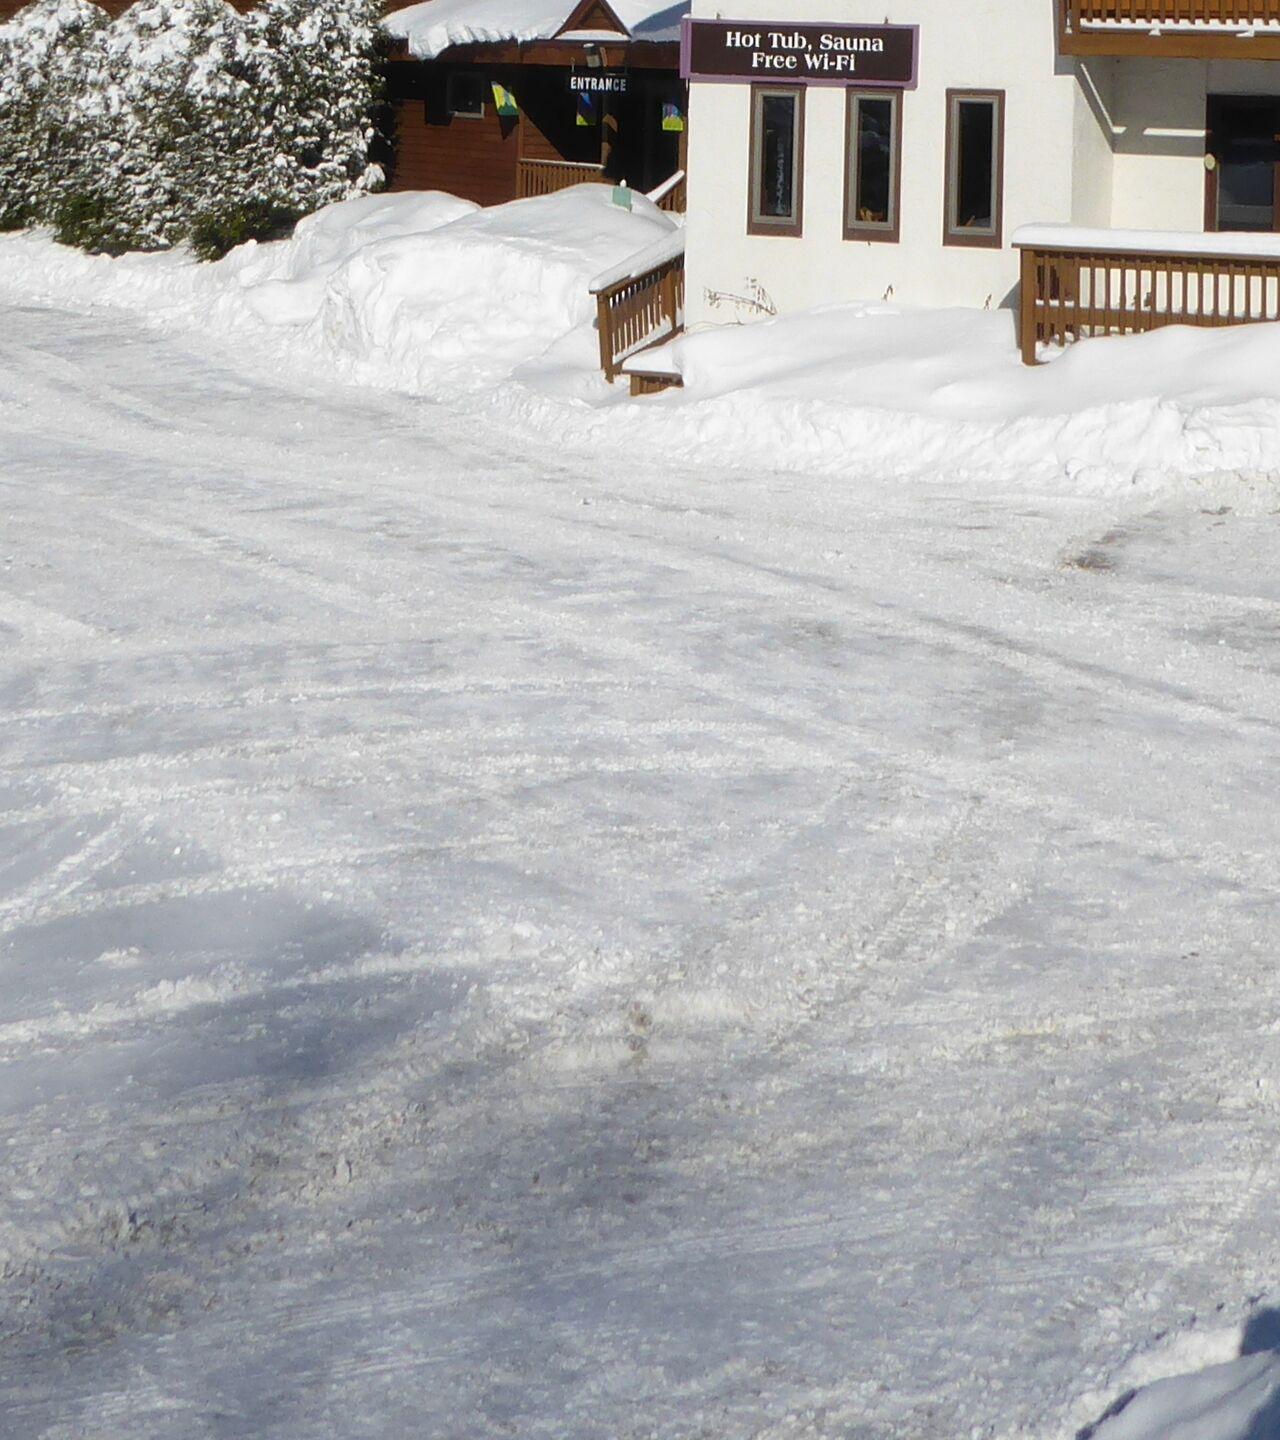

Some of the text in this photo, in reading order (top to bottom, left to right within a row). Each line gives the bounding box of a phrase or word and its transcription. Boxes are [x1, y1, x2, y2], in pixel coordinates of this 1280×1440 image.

[725, 31, 884, 52] Hot Tub, Sauna
[751, 52, 856, 71] Free Wi-Fi
[570, 76, 627, 92] ENTRANCE
